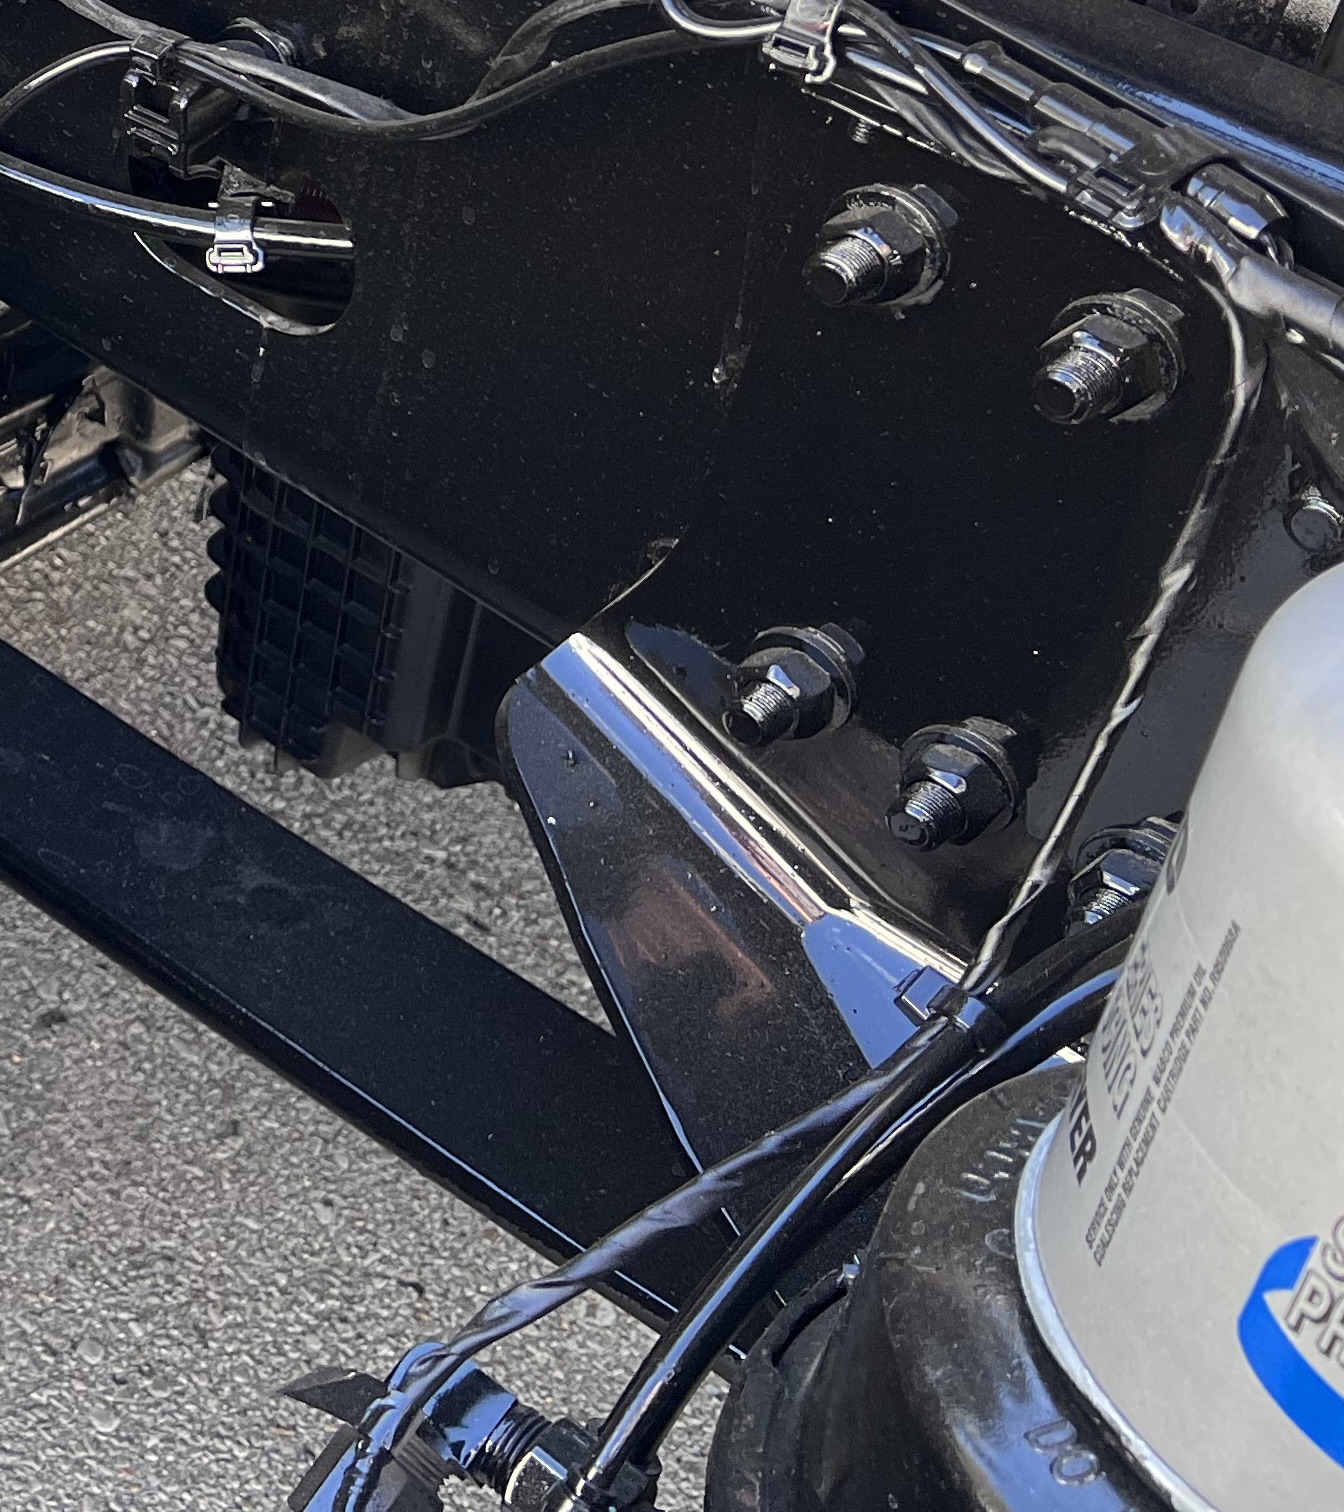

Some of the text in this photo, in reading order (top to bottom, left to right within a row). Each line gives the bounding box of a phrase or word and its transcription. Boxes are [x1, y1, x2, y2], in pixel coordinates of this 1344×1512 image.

[1084, 962, 1207, 1250] SERVICE ONLY WITH GENUINE WABCO PREMIUM OIL
[1092, 1193, 1127, 1268] COALESCING
[1120, 1110, 1162, 1199] REPLACEMENT
[1157, 1039, 1193, 1116] CARTRIDGE
[1184, 1006, 1206, 1048] PART
